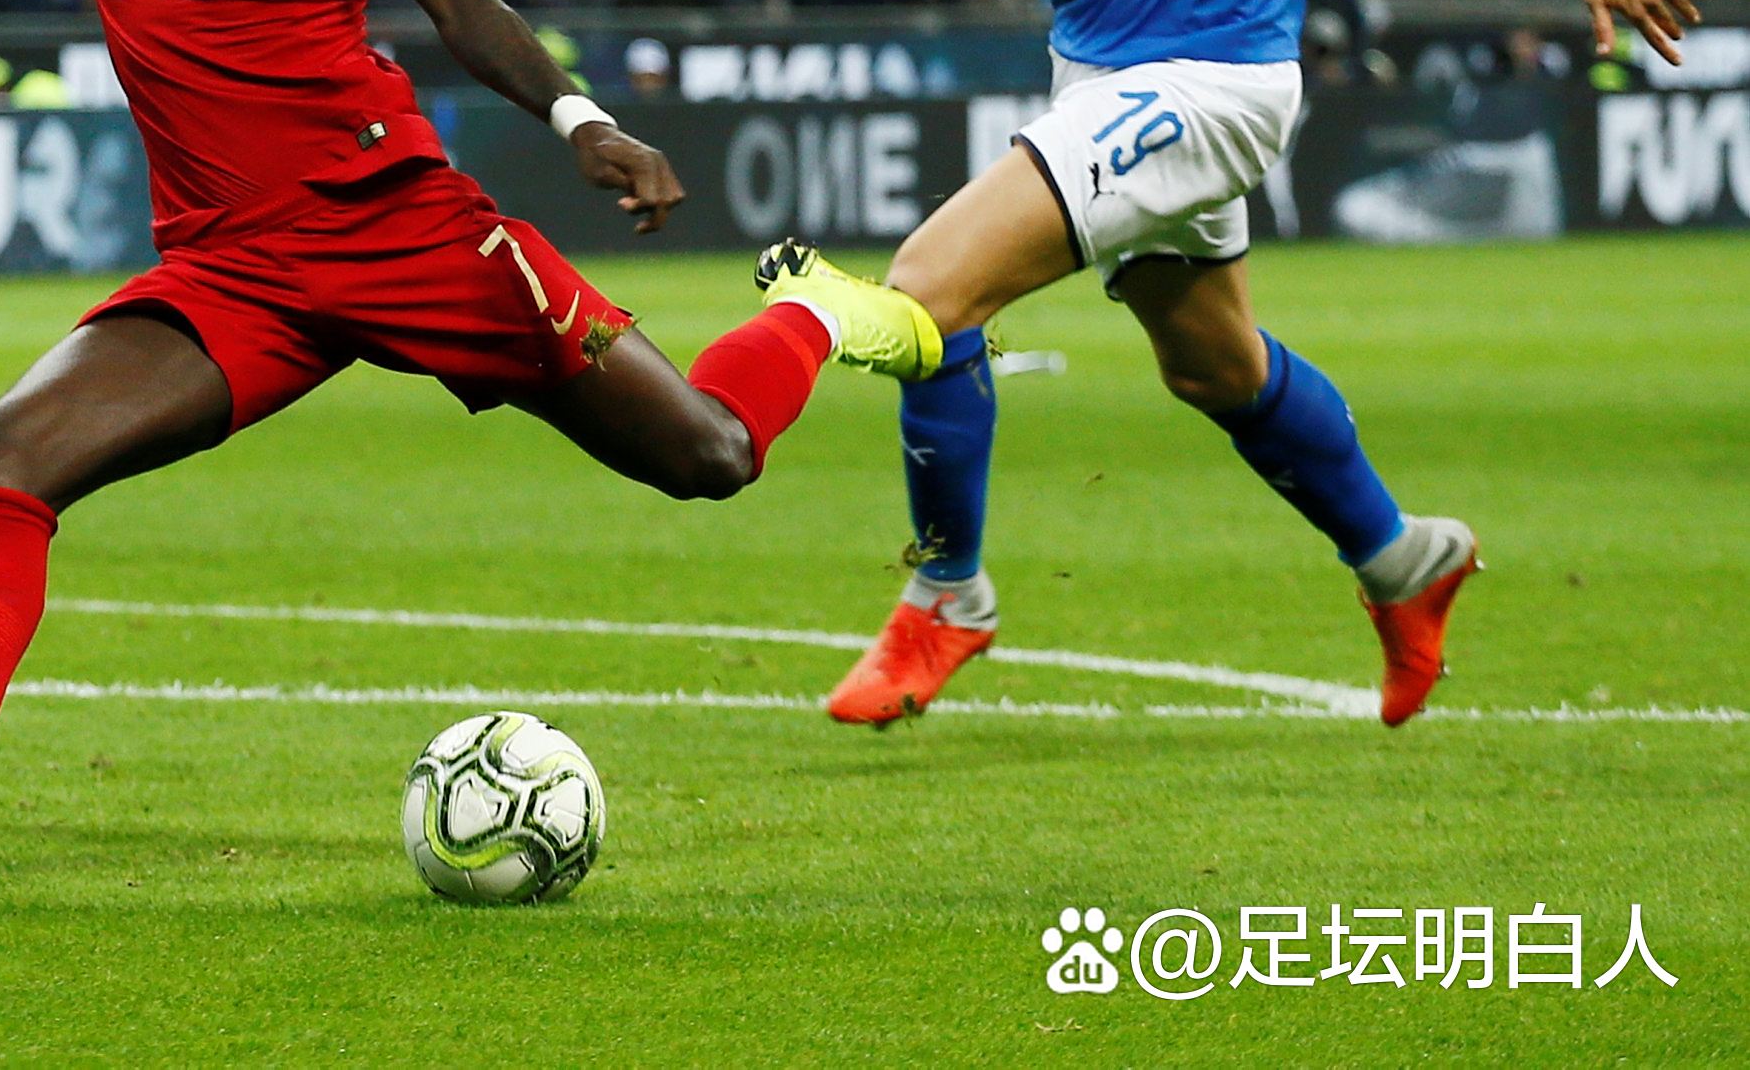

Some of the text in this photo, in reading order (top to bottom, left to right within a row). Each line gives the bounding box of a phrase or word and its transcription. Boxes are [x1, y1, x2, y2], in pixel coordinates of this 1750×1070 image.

[724, 113, 922, 239] ONE
[1092, 91, 1184, 176] 19
[478, 224, 549, 314] 7
